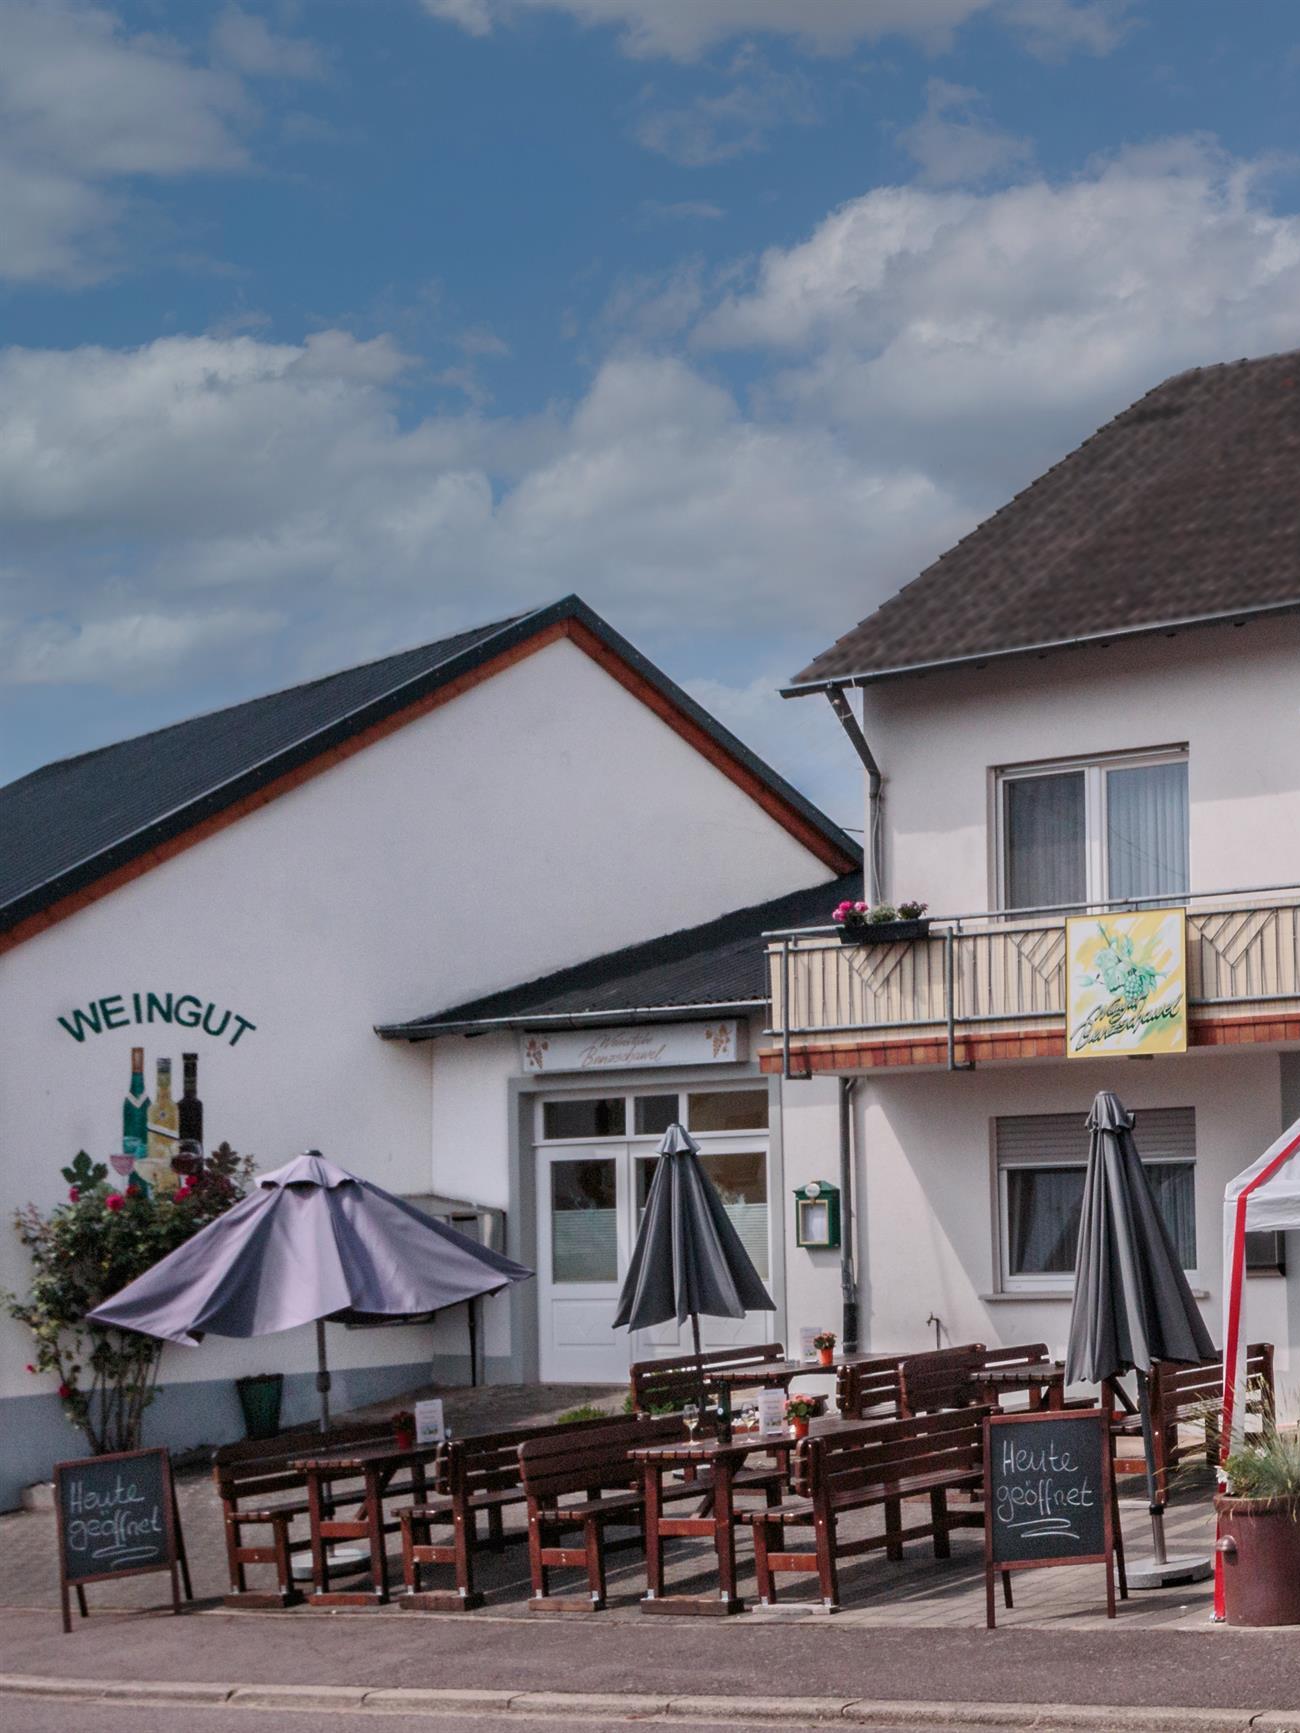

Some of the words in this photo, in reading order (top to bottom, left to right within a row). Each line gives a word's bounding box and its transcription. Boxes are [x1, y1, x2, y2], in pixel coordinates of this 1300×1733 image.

[57, 993, 257, 1047] WEINGUT
[1003, 1440, 1079, 1476] Heute
[70, 1475, 145, 1513] Heute
[997, 1475, 1094, 1522] geöffnet
[69, 1506, 162, 1551] geöffnet
